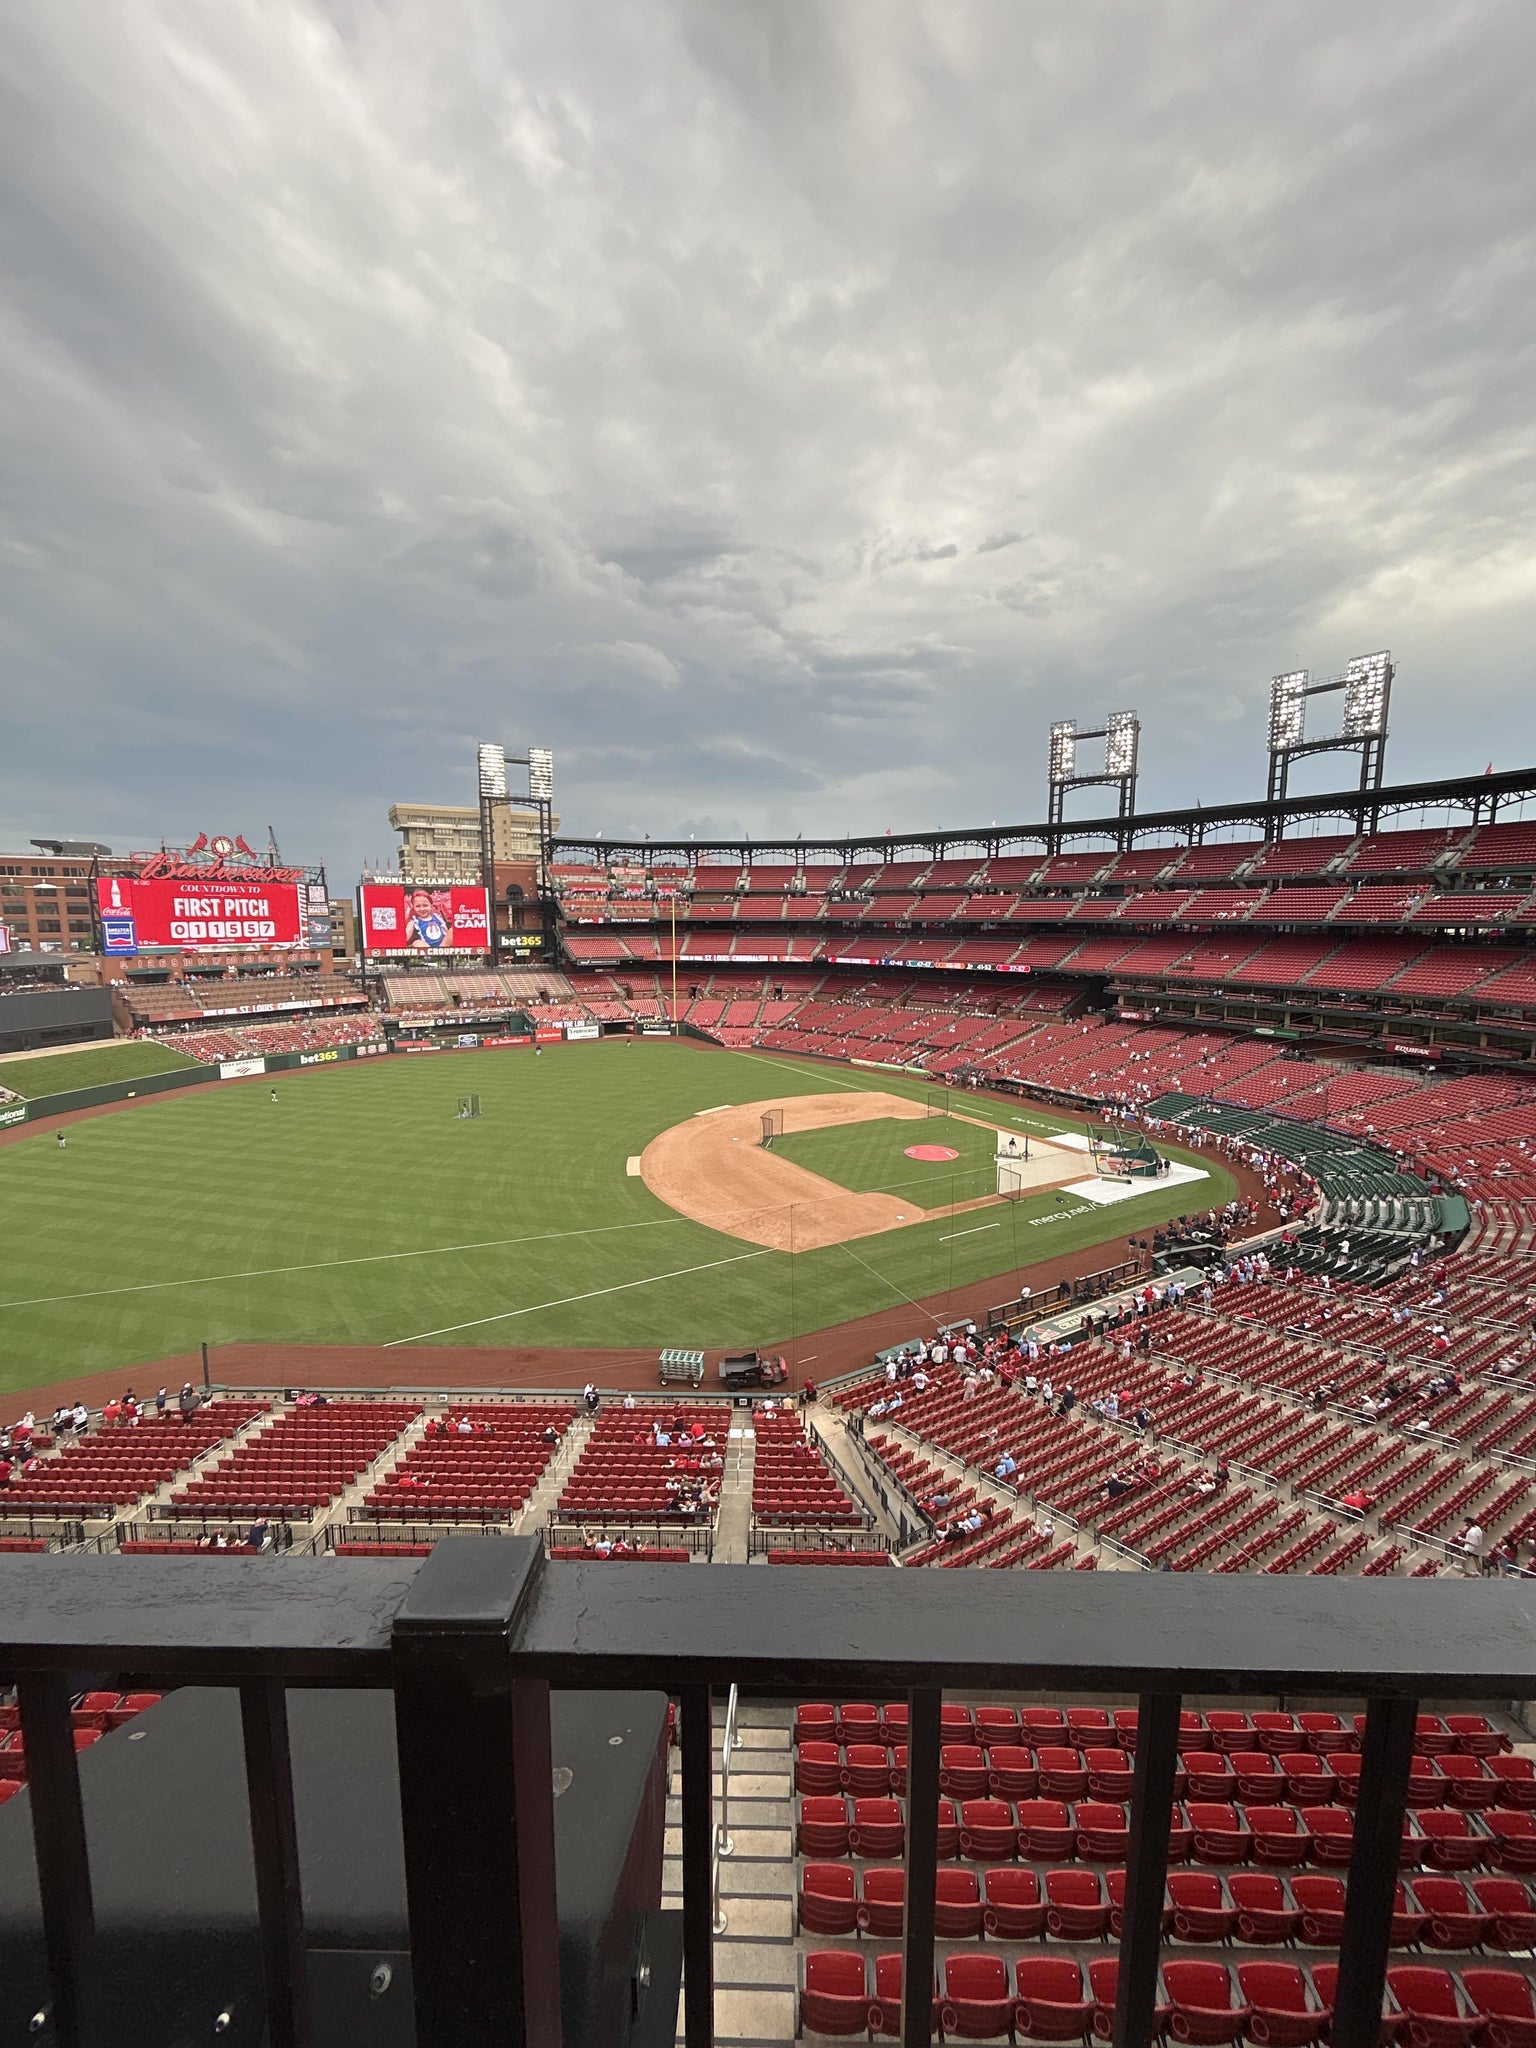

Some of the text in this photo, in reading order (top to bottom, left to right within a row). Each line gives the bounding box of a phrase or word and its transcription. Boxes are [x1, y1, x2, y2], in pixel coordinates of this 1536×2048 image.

[130, 852, 304, 880] Budweiser
[373, 876, 476, 885] WORLD CHAMPIONS
[180, 884, 260, 894] COUNTDOWN TO
[103, 907, 131, 916] Coca-Cola
[173, 897, 269, 917] FIRST PITCH
[454, 920, 486, 928] CAM
[501, 935, 542, 946] bet365
[386, 948, 418, 956] BROWN
[427, 947, 473, 955] CROUPPEN
[253, 1004, 274, 1012] LOUIS
[278, 1000, 316, 1010] CARDINALS
[1394, 1044, 1430, 1056] EQUIFAX
[300, 1051, 338, 1064] bet365
